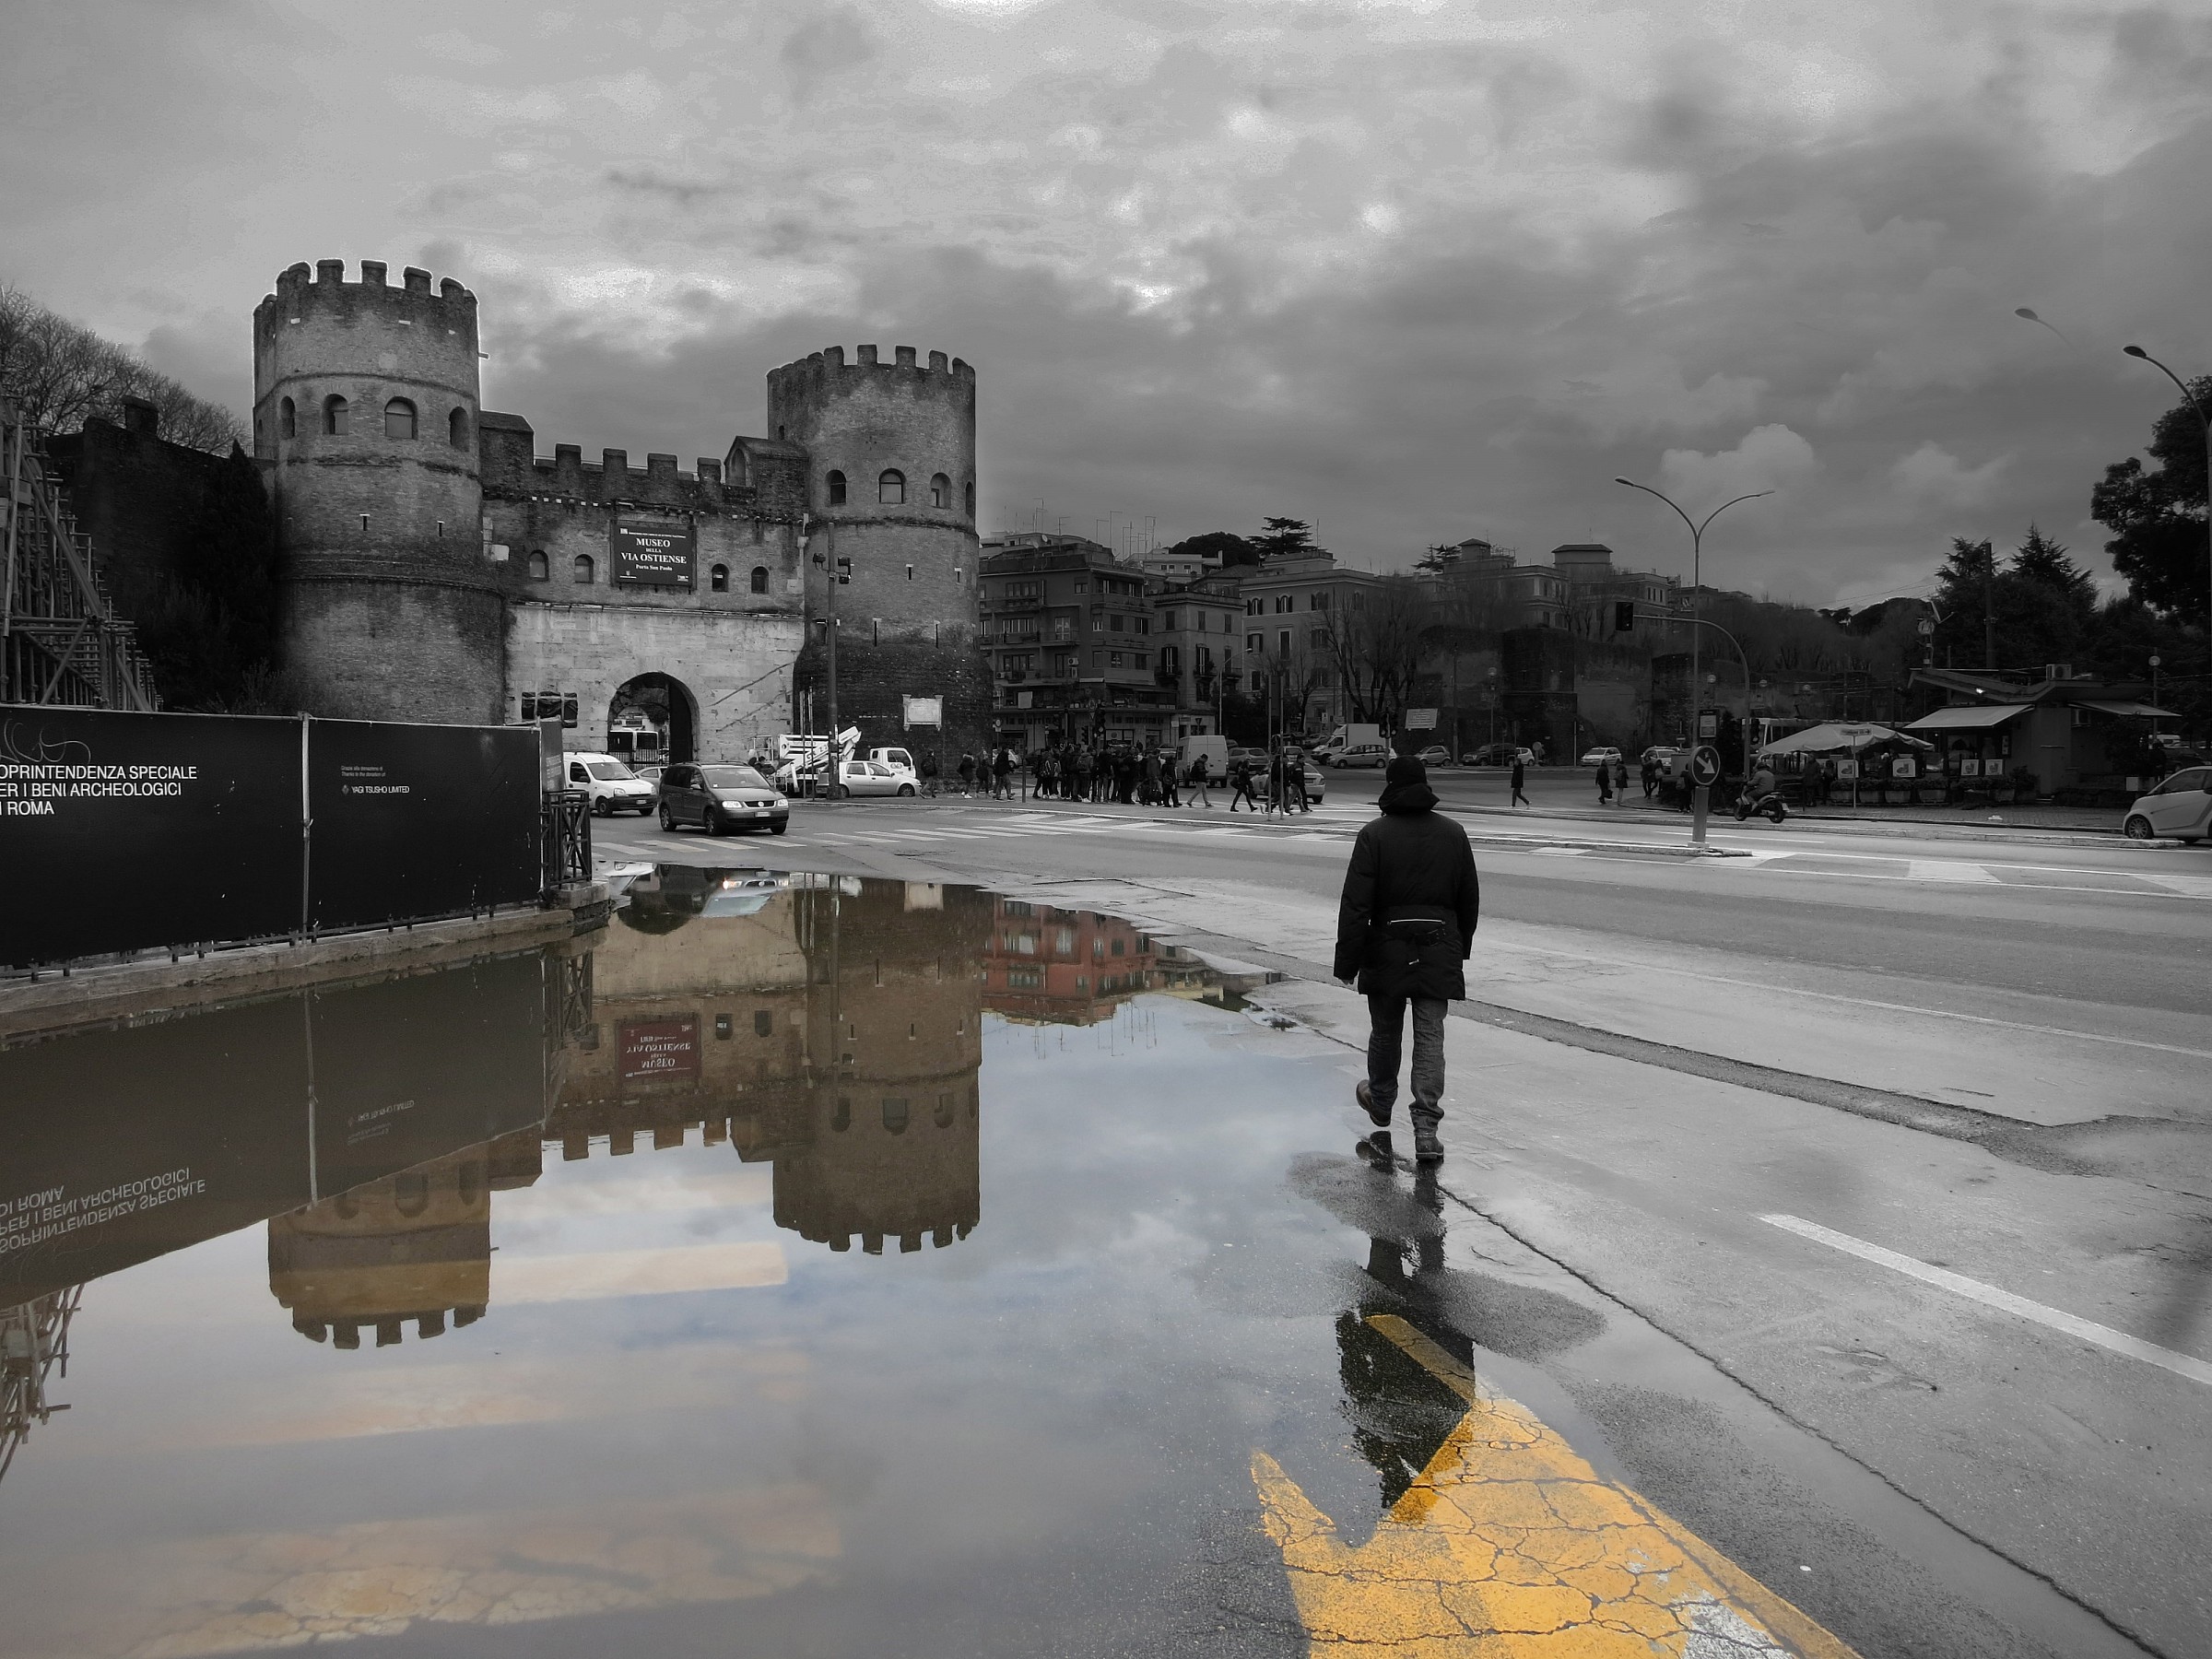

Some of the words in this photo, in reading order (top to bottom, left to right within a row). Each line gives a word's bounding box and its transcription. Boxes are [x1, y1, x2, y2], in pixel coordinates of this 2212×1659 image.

[636, 538, 671, 547] MUSEO
[621, 552, 639, 560] VIA
[641, 554, 687, 564] OSTIENSE
[128, 766, 197, 780] SPECIALE
[23, 783, 27, 797] I
[31, 783, 66, 797] BENI
[69, 782, 182, 796] ARCHEOLOGICI
[7, 801, 54, 816] ROMA
